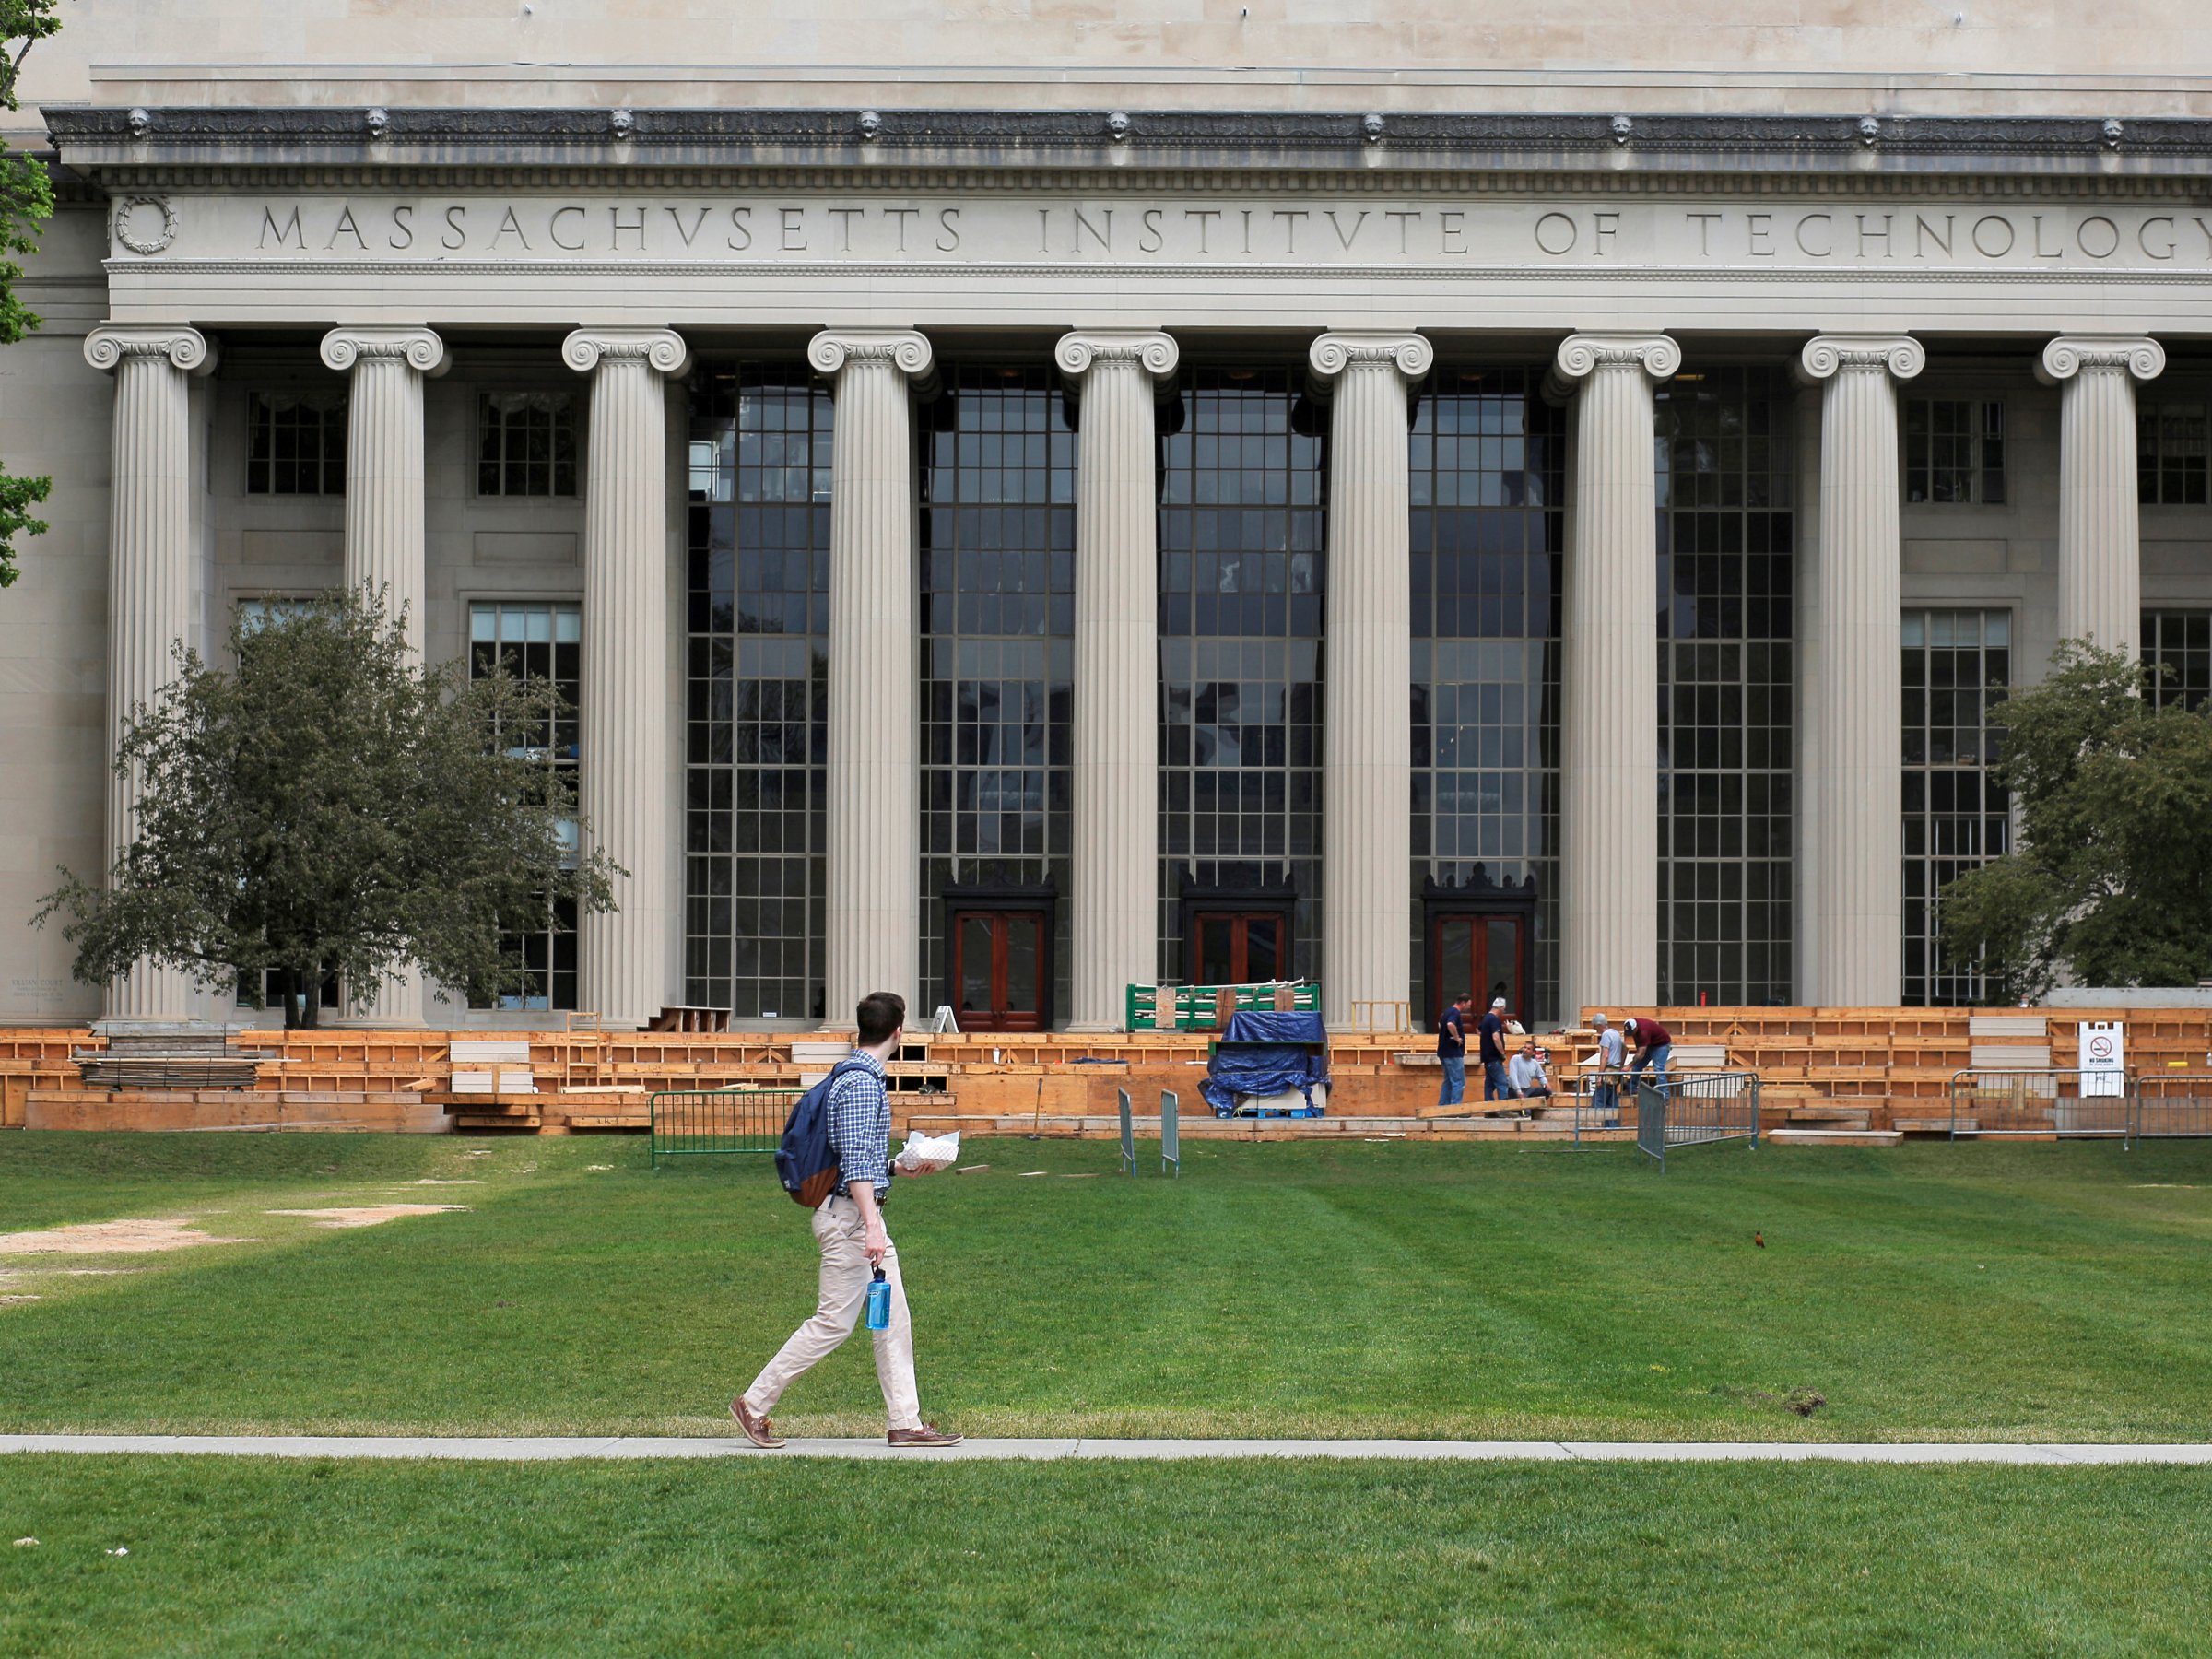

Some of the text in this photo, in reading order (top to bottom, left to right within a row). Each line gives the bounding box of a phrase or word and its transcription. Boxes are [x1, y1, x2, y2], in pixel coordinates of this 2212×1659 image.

[255, 206, 960, 253] MASSACHVSETTS
[1039, 208, 1468, 255] INSTITVTE
[1535, 211, 1620, 257] OF
